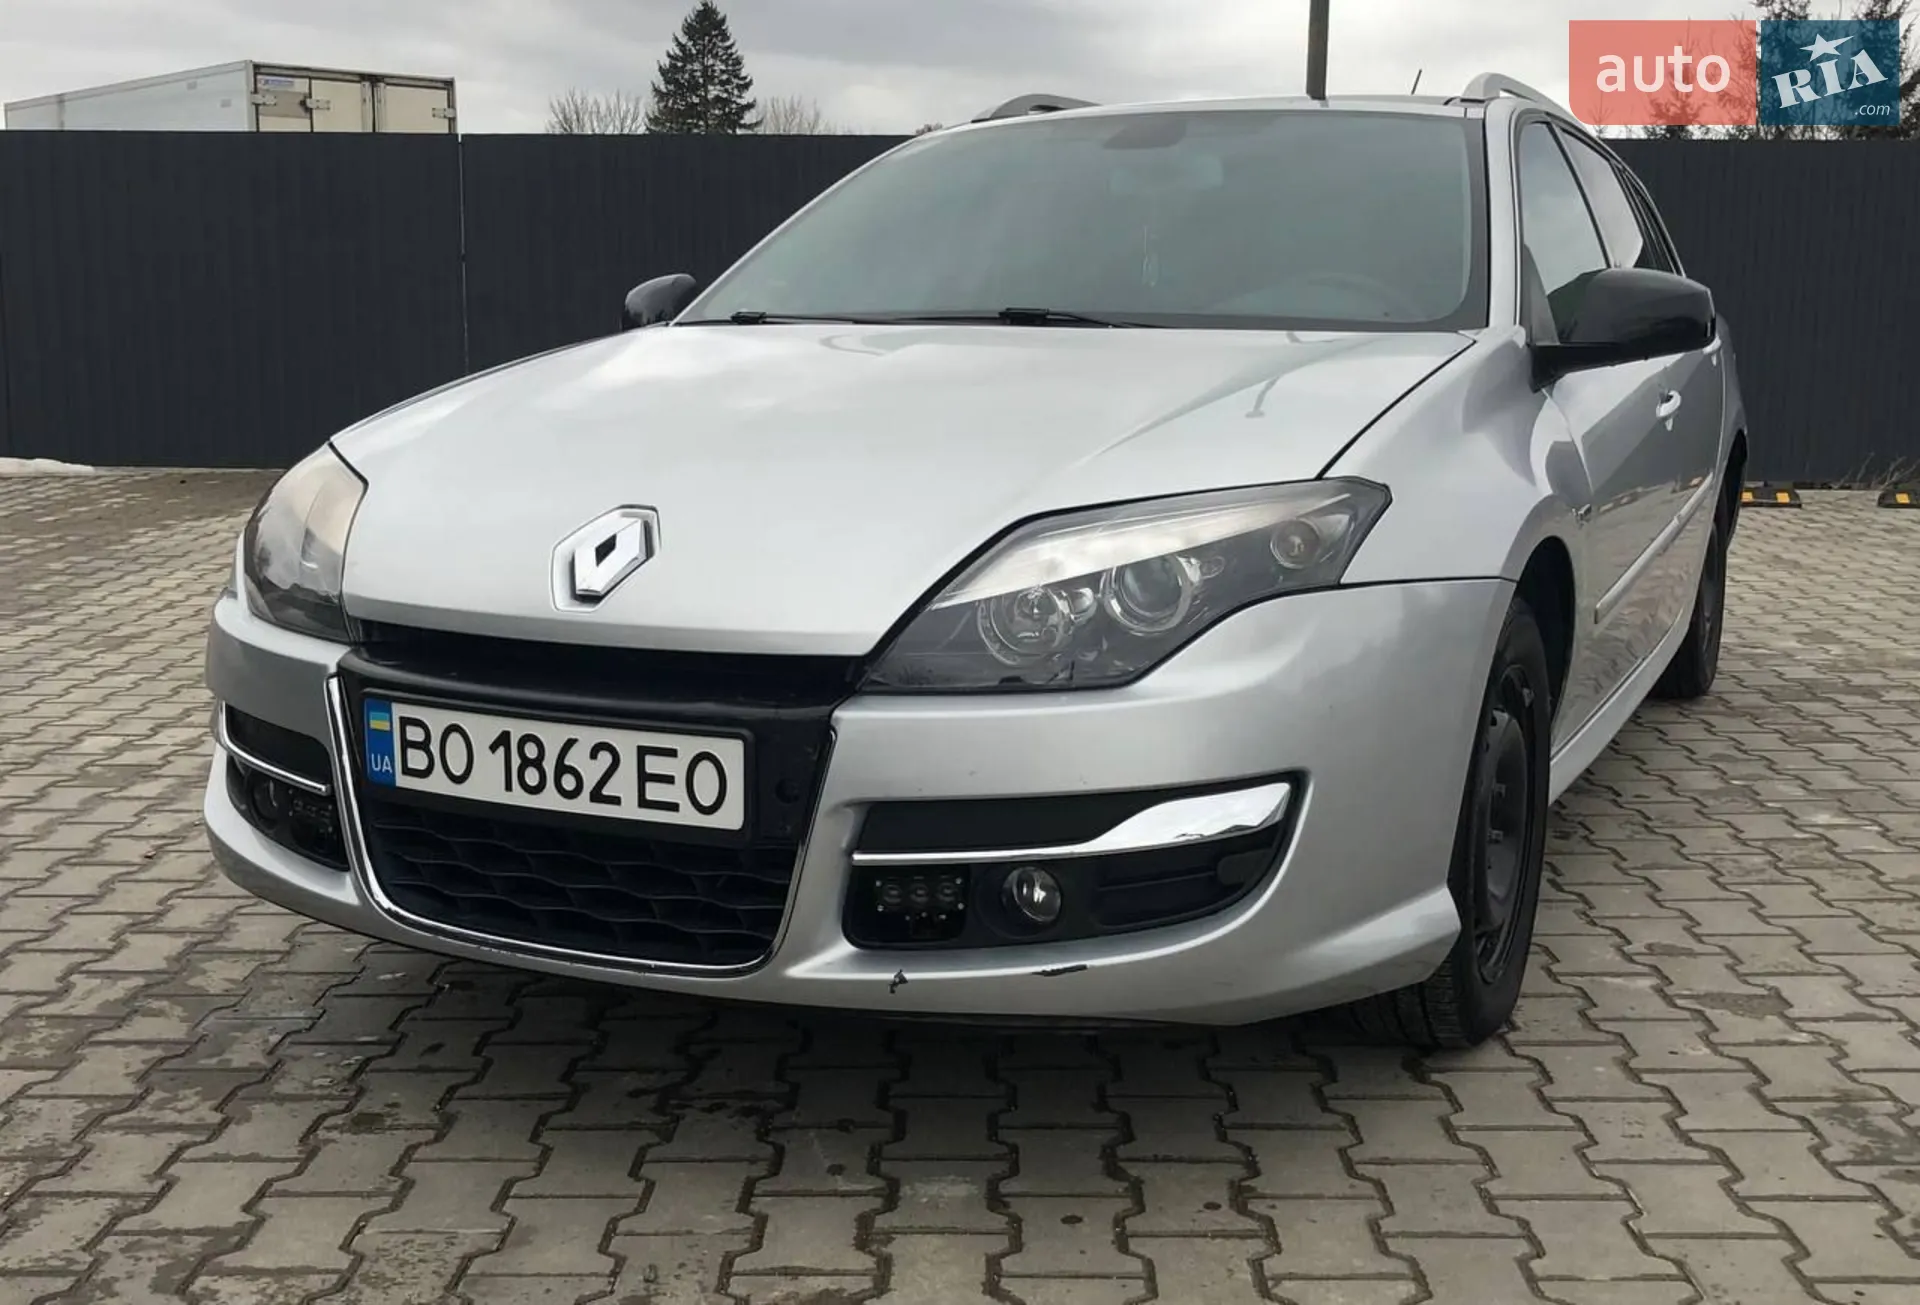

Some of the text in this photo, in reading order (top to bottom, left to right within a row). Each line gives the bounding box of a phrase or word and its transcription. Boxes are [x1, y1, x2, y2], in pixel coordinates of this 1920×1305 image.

[370, 753, 393, 774] UA
[399, 716, 727, 816] BO 1862 EO
